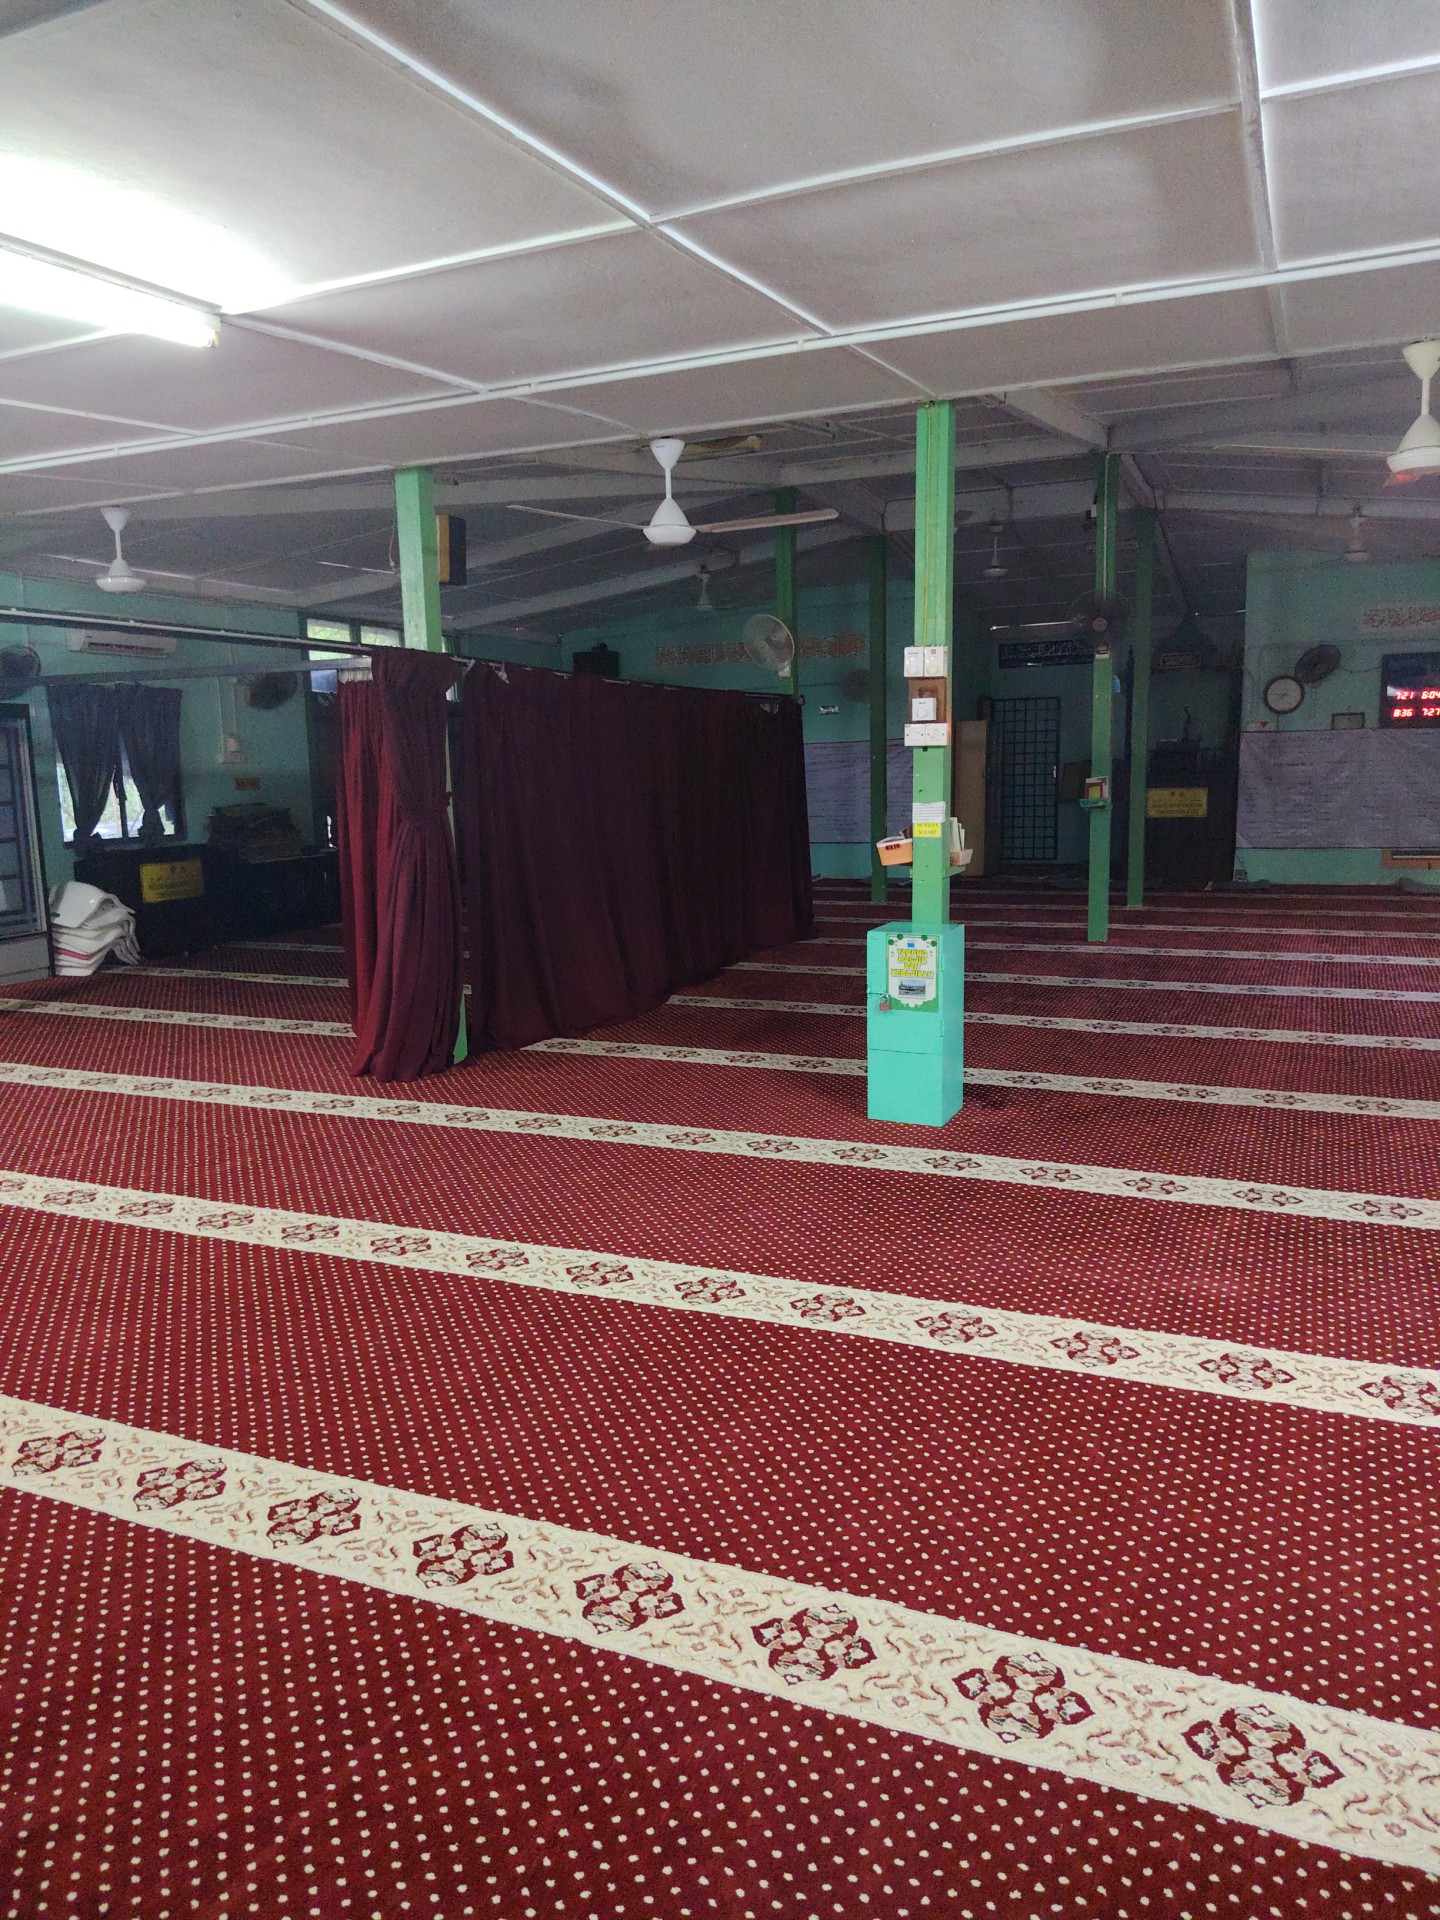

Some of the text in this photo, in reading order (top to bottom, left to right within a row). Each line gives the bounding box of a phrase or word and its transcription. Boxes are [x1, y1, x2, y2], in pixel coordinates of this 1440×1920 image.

[897, 948, 928, 957] TABUNG
[897, 955, 928, 964] MASJID
[890, 969, 934, 979] KEBAJIKAN
